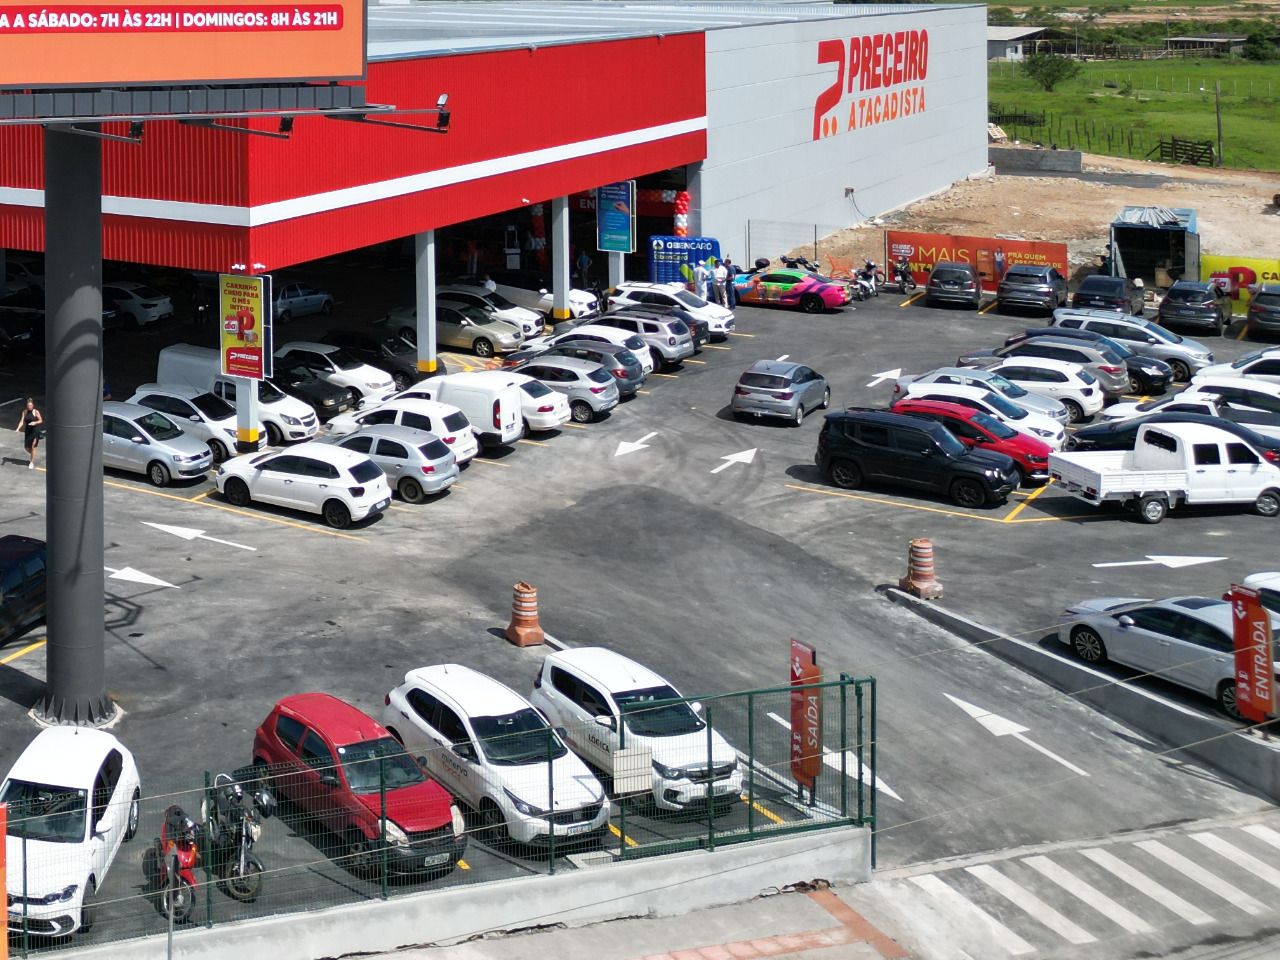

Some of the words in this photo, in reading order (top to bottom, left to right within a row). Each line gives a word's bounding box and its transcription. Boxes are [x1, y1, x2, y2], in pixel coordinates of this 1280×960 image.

[13, 13, 25, 28] A
[28, 9, 97, 28] SÁBADO:
[100, 13, 119, 27] 7H
[122, 9, 142, 27] ÀS
[145, 13, 171, 27] 22H
[183, 12, 268, 27] DOMINGOS:
[271, 12, 289, 26] 8H
[292, 9, 311, 26] ÀS
[313, 11, 338, 25] 21H
[848, 29, 928, 93] PRECEIRO
[848, 86, 925, 131] ATACADISTA
[918, 246, 970, 263] MAIS
[1024, 253, 1046, 261] QUEM
[224, 289, 242, 297] CHEIO
[226, 282, 258, 291] CARRINHO
[230, 304, 254, 312] INTEIRO
[1253, 621, 1268, 700] ENTRADA
[805, 696, 818, 749] SAÍDA
